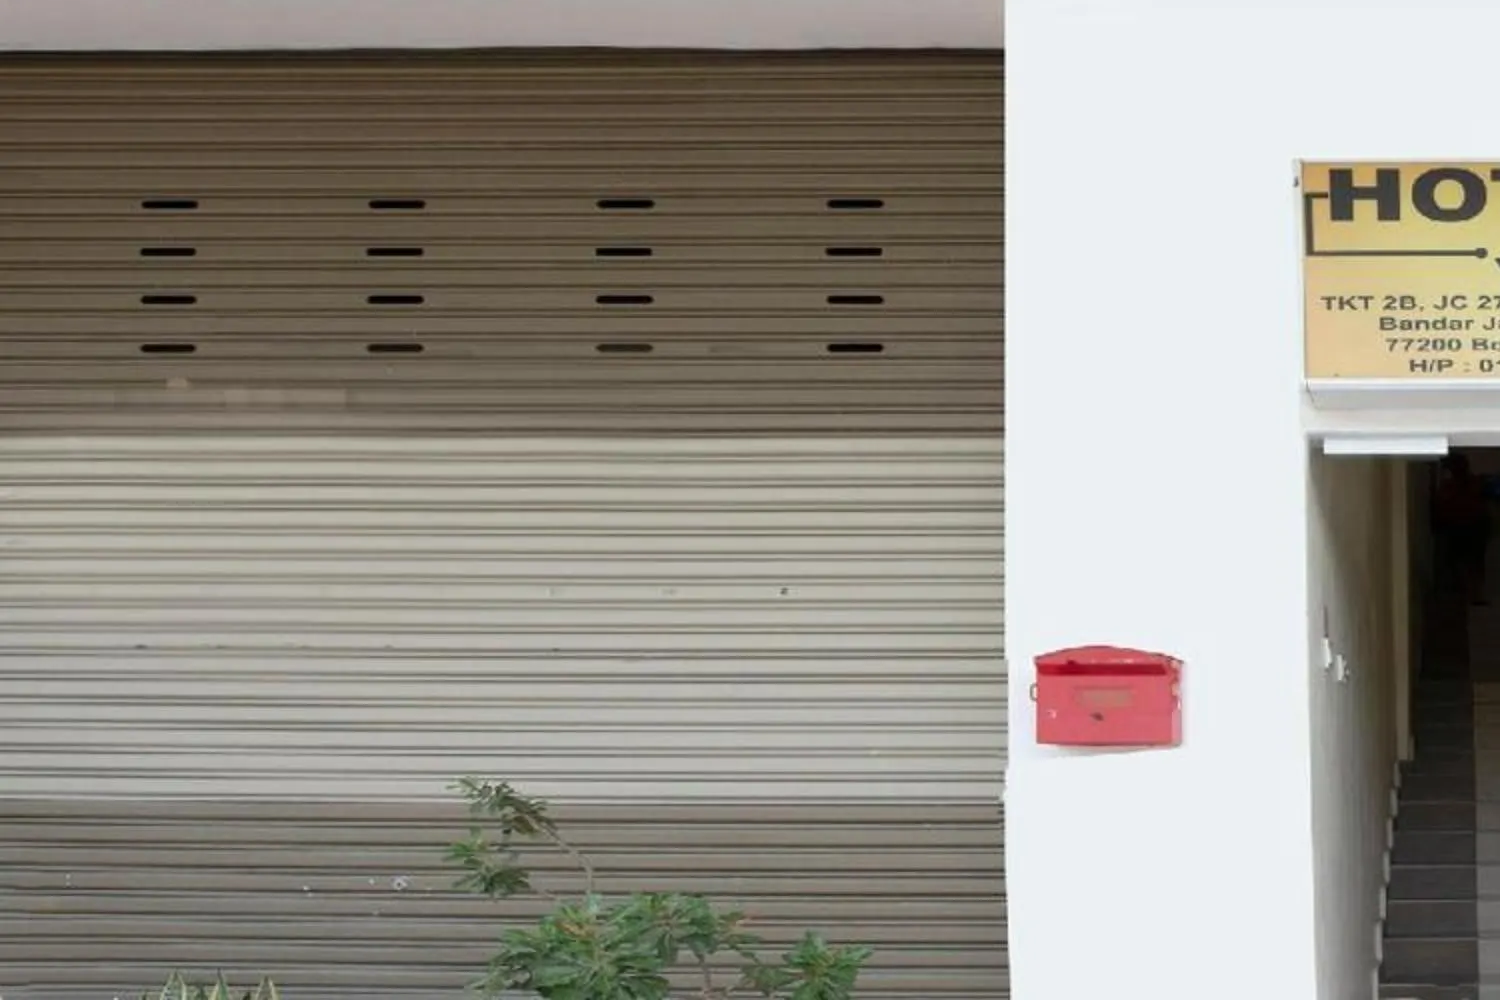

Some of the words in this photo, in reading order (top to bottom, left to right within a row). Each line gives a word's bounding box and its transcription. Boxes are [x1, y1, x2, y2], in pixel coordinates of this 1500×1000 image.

[1320, 295, 1374, 310] TKT
[1382, 294, 1425, 312] 2B,
[1433, 295, 1468, 310] JC
[1379, 316, 1474, 331] Bandar
[1385, 338, 1462, 352] 77200
[1409, 359, 1454, 373] H/P
